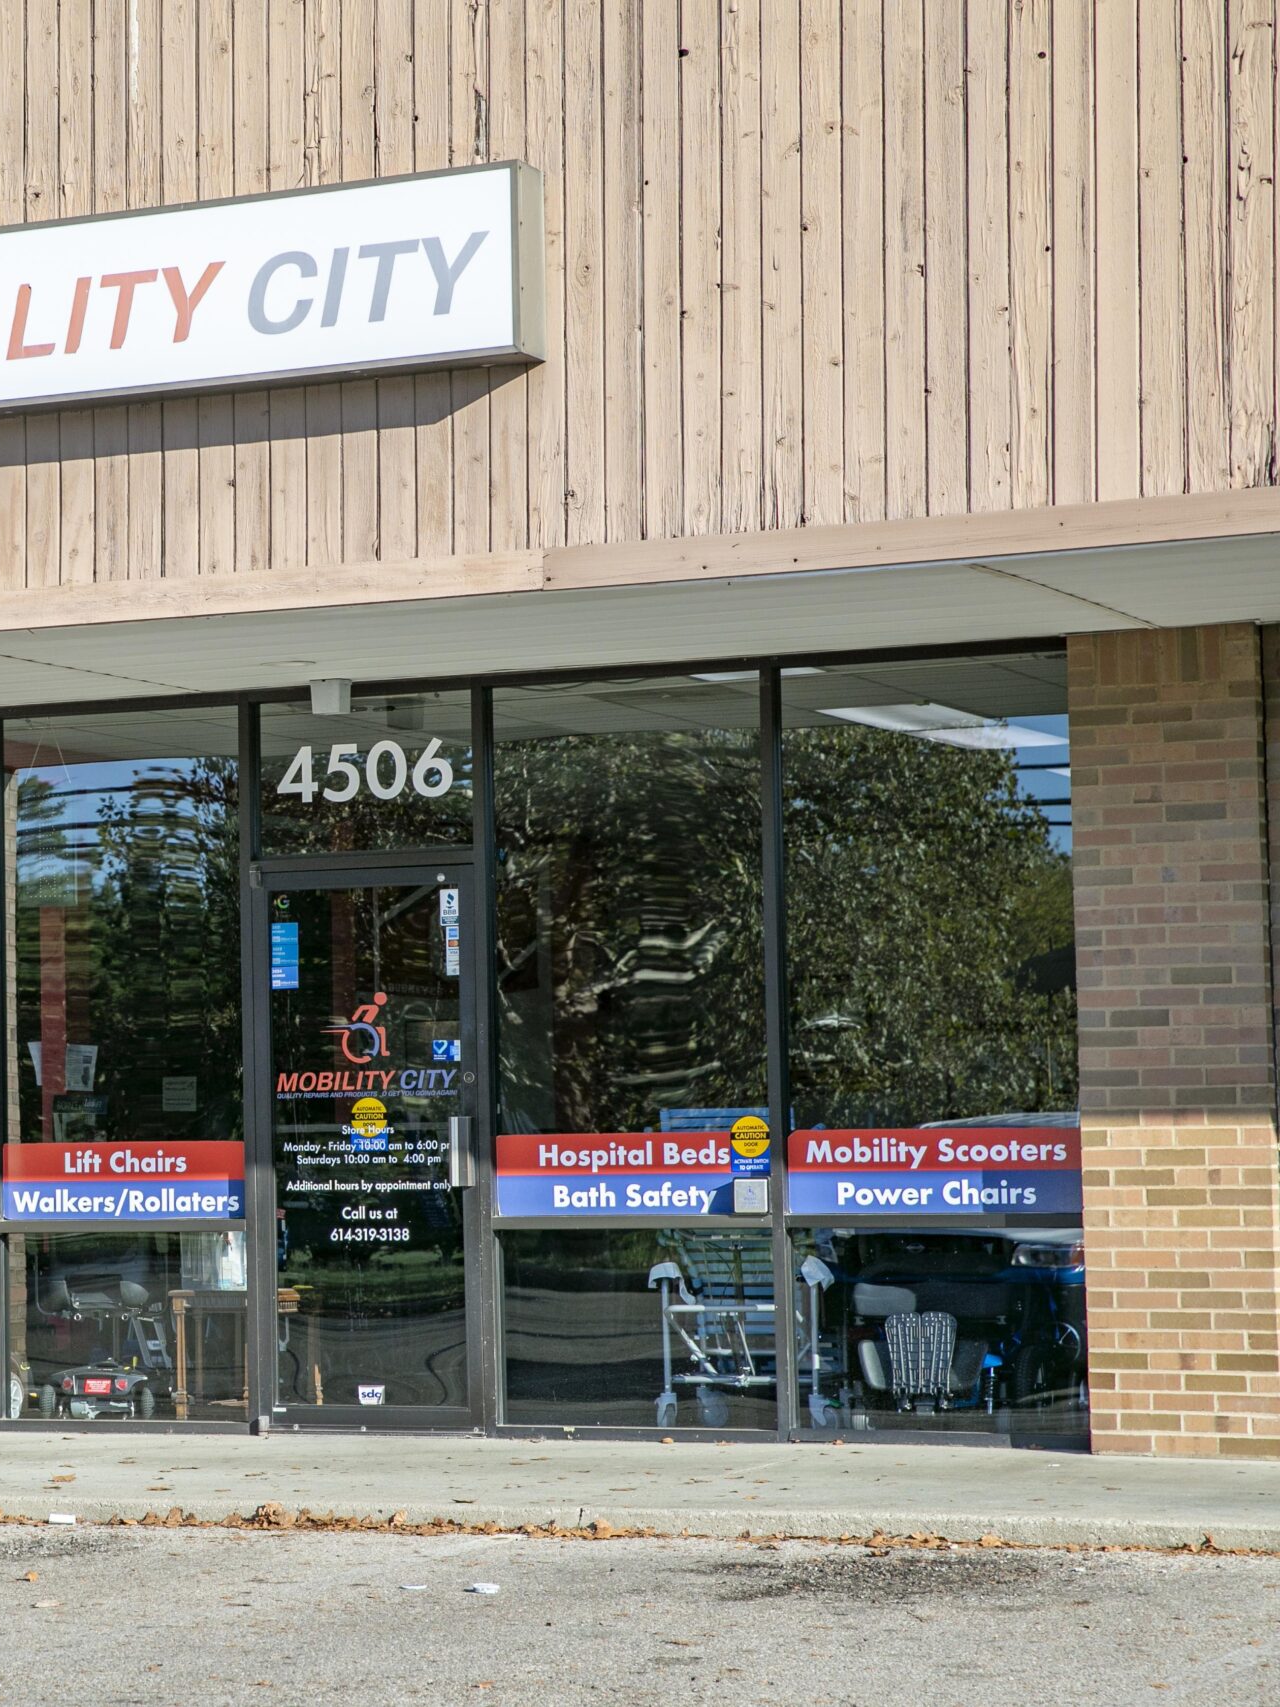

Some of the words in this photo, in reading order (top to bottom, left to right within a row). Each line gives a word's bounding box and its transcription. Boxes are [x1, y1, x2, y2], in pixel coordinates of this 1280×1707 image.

[247, 230, 490, 336] CITY
[277, 737, 454, 803] 4506
[277, 1070, 396, 1092] MOBILITY
[400, 1069, 458, 1090] CITY
[342, 1125, 365, 1135] Store
[368, 1124, 395, 1134] Hours
[283, 1142, 321, 1154] Monday
[328, 1141, 356, 1153] Friday
[360, 1140, 386, 1150] 10:00
[404, 1141, 414, 1150] to
[416, 1140, 438, 1150] 6:00
[538, 1141, 653, 1173] Hospital
[663, 1140, 730, 1166] Beds
[806, 1137, 928, 1169] Mobility
[937, 1138, 1068, 1162] Scooters
[64, 1150, 102, 1173] Lift
[109, 1149, 188, 1173] Chairs
[296, 1155, 341, 1167] Saturdays
[344, 1154, 370, 1164] 10:00
[372, 1156, 387, 1164] am
[388, 1155, 398, 1164] to
[403, 1154, 425, 1163] 4:00
[427, 1156, 441, 1165] pm
[286, 1180, 333, 1191] Additional
[334, 1180, 360, 1191] hours
[361, 1180, 372, 1192] by
[375, 1181, 431, 1192] appointment
[553, 1182, 617, 1208] Bath
[626, 1182, 718, 1213] Safety
[837, 1181, 933, 1206] Power
[942, 1180, 1037, 1205] Chairs
[12, 1188, 240, 1216] Walkers/Rollaters
[342, 1206, 366, 1220] Call
[369, 1209, 382, 1219] us
[385, 1207, 398, 1219] at
[330, 1228, 410, 1242] 614-319-3138
